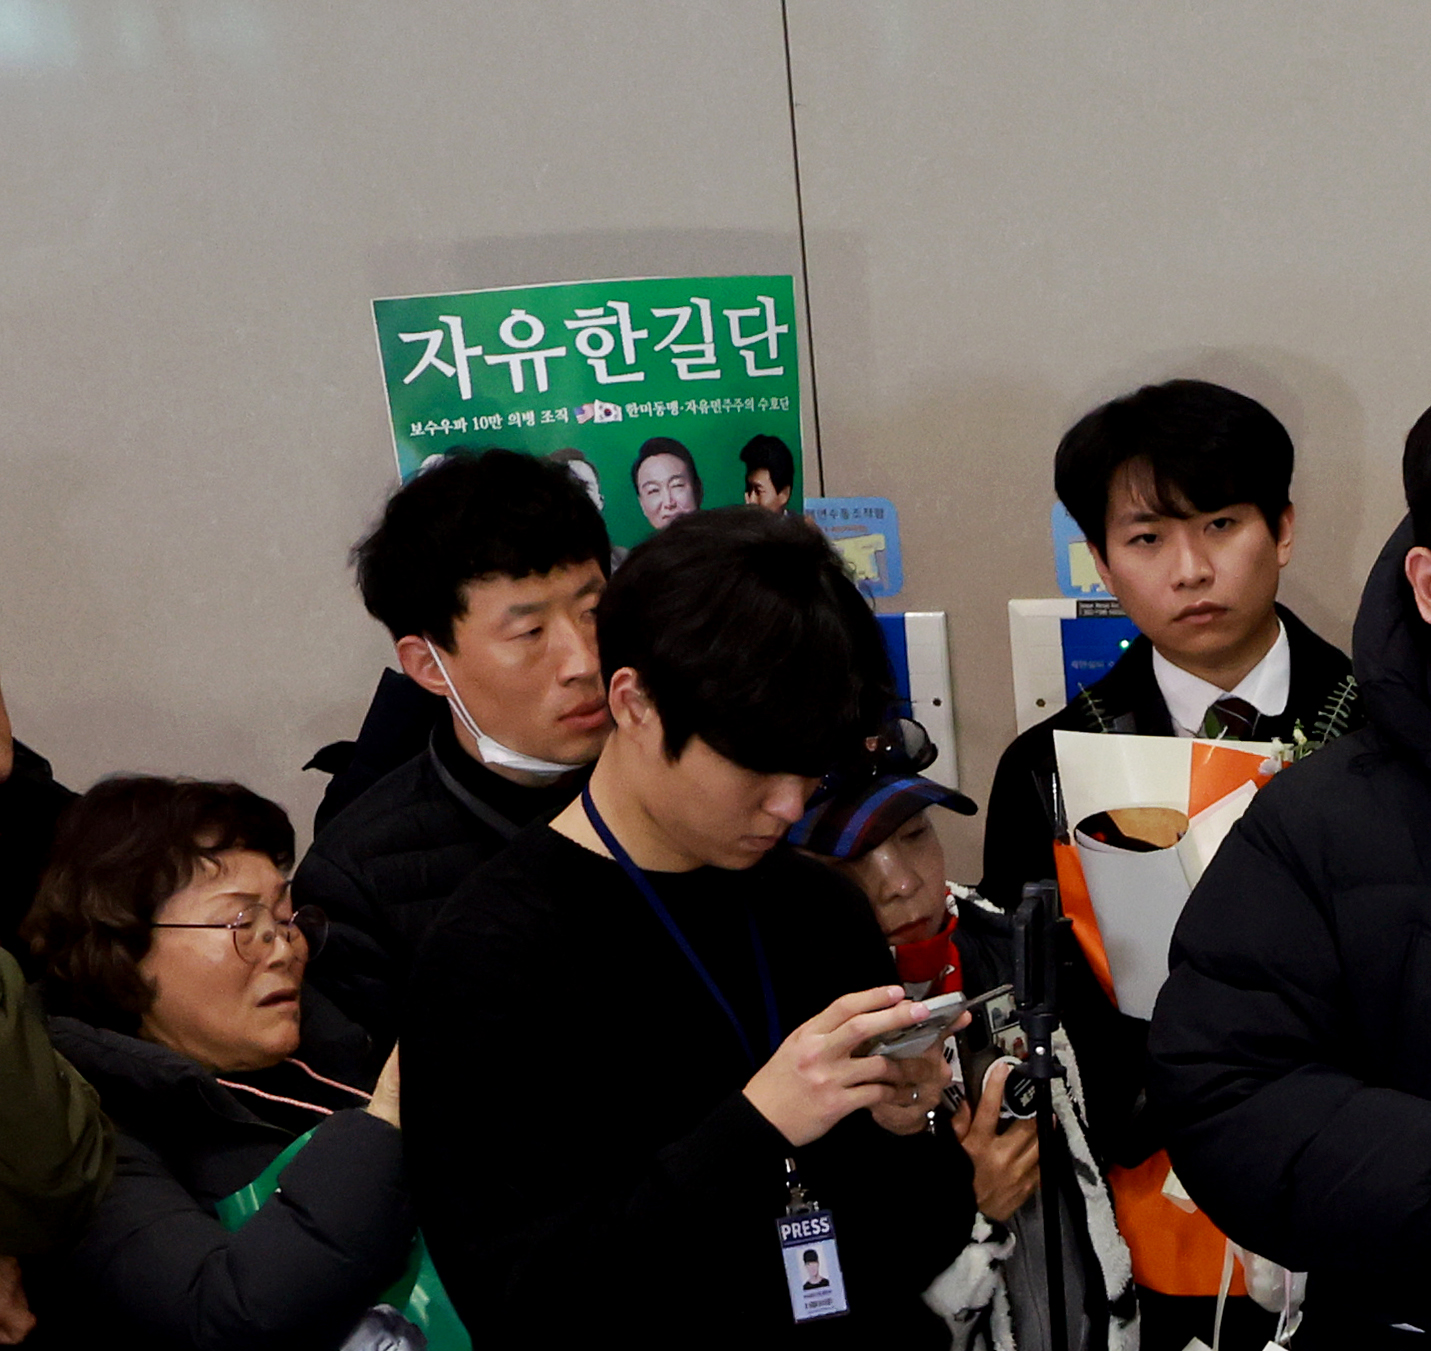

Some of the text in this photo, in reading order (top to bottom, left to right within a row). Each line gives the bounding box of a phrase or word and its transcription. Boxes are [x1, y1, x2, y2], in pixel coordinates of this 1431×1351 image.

[398, 295, 788, 400] 자유한길단
[472, 412, 503, 431] 10만
[540, 407, 569, 424] 조직
[780, 1217, 831, 1241] PRESS
